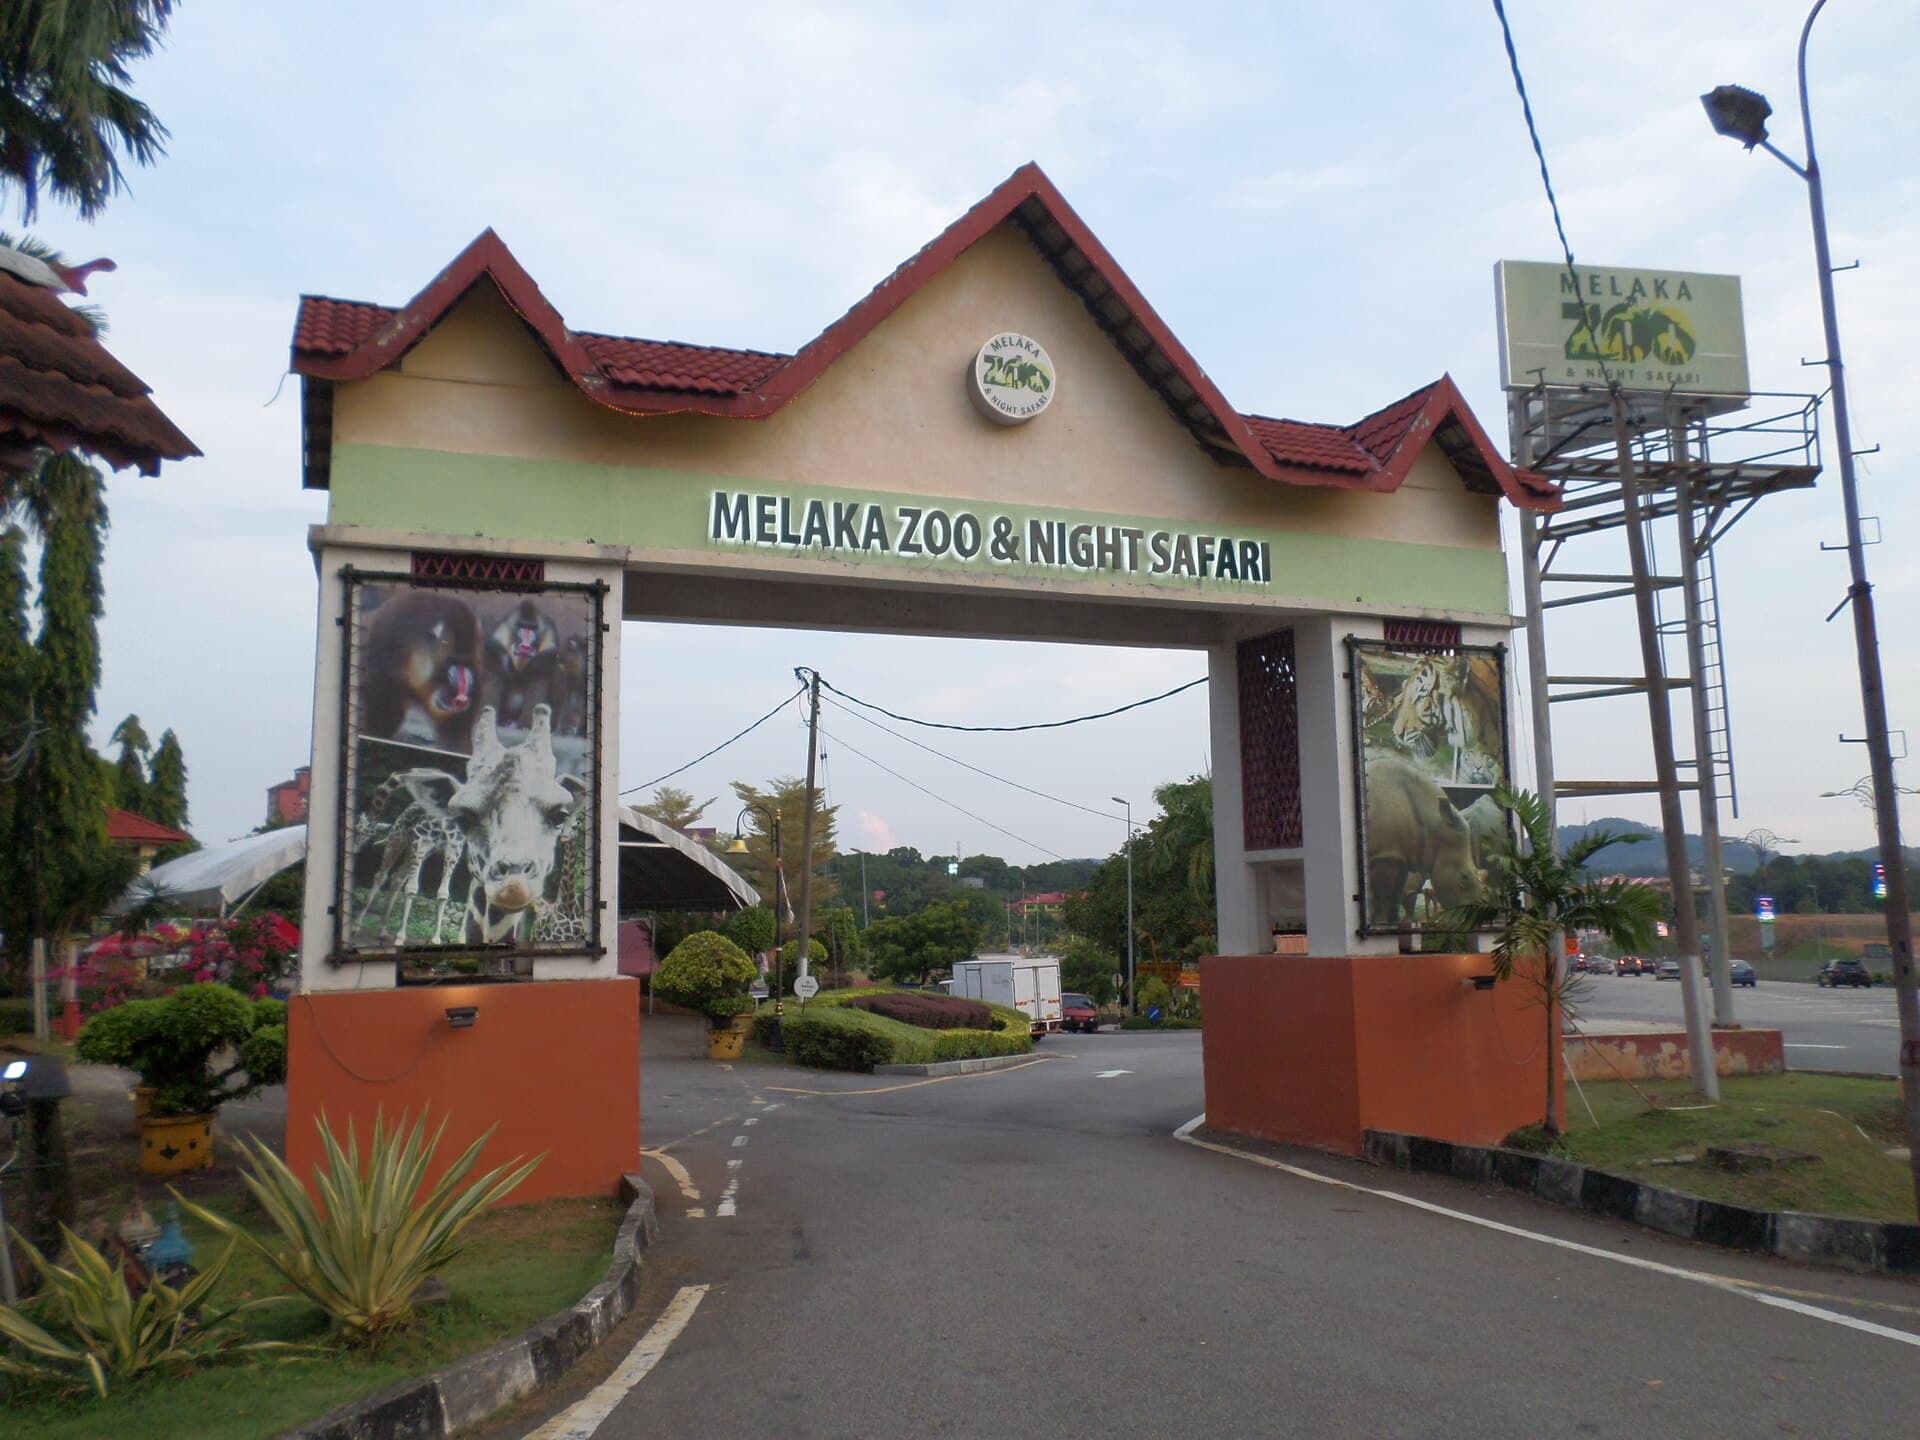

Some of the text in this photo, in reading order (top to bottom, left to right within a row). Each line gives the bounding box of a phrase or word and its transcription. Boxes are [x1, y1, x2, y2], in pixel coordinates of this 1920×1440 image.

[1560, 273, 1693, 302] MELAKA
[990, 336, 1040, 358] MELAKA
[1566, 367, 1700, 384] & NIGHT SAFARI
[991, 395, 1017, 414] NIGHT
[1021, 395, 1048, 415] SAFARI
[712, 491, 1271, 582] MELAKA ZOO & NIGHT SAFARI
